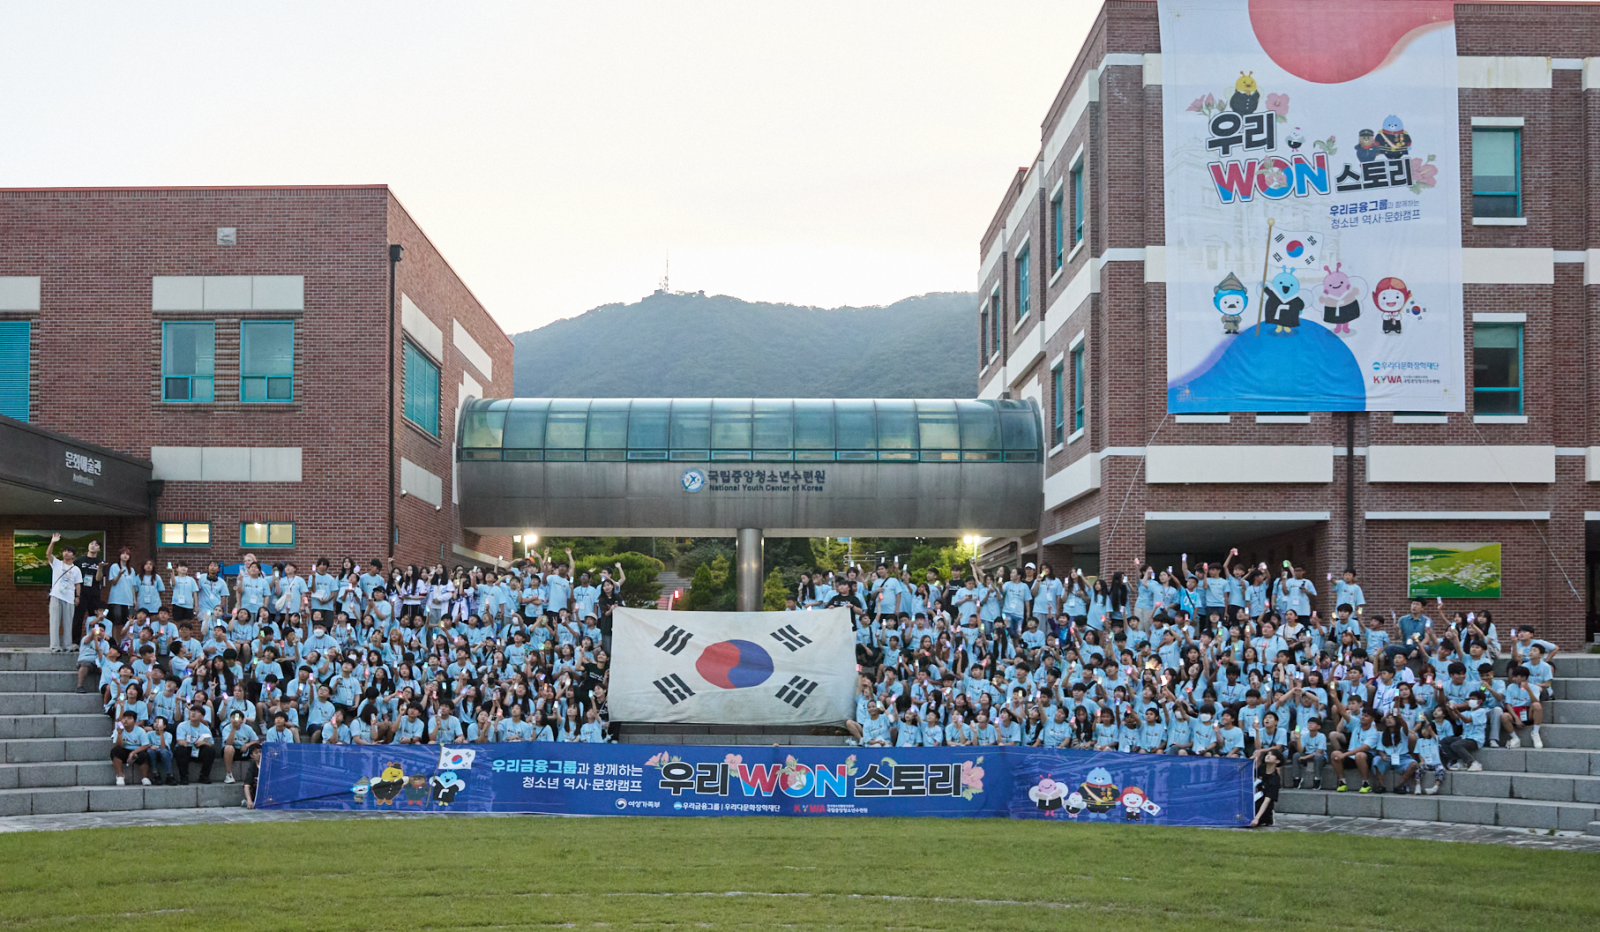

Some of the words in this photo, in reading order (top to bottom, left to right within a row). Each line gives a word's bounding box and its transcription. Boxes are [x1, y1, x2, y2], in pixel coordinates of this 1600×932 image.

[1206, 111, 1276, 156] 우리
[1208, 153, 1331, 203] WON
[1336, 158, 1413, 192] 스토리
[1329, 199, 1394, 216] 우리금융그룹과
[1331, 216, 1359, 230] 청소년
[1381, 361, 1440, 371] 우리다문화장학재단
[1373, 375, 1402, 384] KYWA
[65, 451, 102, 476] 문화예술관
[707, 470, 826, 484] 국립중앙청소년수련원
[709, 484, 740, 492] National
[742, 484, 764, 492] Youth
[765, 484, 791, 492] Center
[791, 484, 800, 492] of
[801, 484, 823, 492] Korea
[491, 759, 590, 775] 우리금융그룹과
[593, 763, 643, 777] 함께하는
[522, 776, 559, 789] 청소년
[659, 762, 730, 796] 우리
[738, 763, 848, 798] WON
[854, 764, 963, 797] 스토리
[628, 800, 660, 808] 여성가족부
[683, 802, 720, 811] 우리금융그룹
[724, 803, 780, 812] 우리다문화장학재단
[794, 804, 826, 813] KYWA
